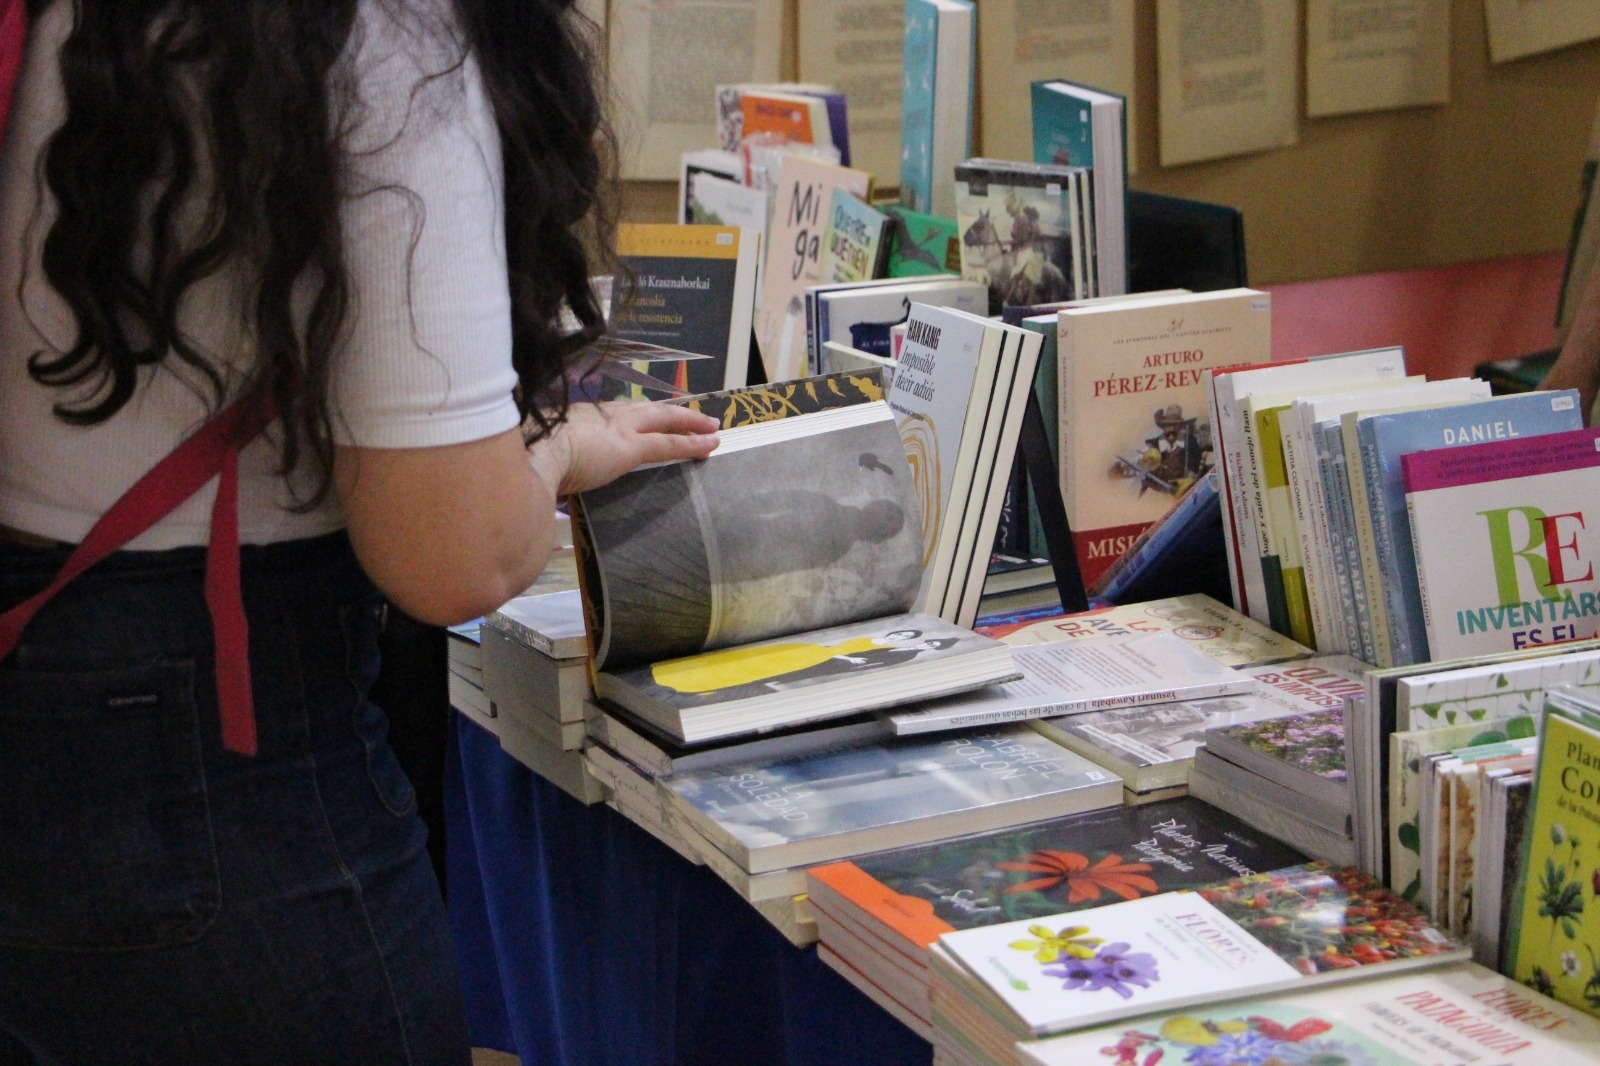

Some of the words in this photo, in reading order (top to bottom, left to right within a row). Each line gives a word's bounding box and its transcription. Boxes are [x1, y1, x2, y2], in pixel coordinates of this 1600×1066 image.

[788, 180, 822, 227] Mi
[792, 229, 819, 281] ga
[648, 275, 710, 290] Krasznahorkai
[640, 312, 683, 324] resistencia
[907, 318, 924, 343] HAN
[920, 323, 941, 350] KANG
[900, 345, 936, 375] Imposible
[1143, 349, 1204, 369] ARTURO
[894, 370, 915, 393] decir
[913, 379, 935, 402] adiós
[1093, 362, 1252, 397] PÉREZ-REV
[1240, 409, 1251, 433] Bam
[1443, 420, 1519, 445] DANIEL
[1244, 436, 1257, 470] conejo
[1367, 444, 1378, 478] DANIEL
[1233, 451, 1246, 486] Richard
[1250, 472, 1259, 488] del
[1284, 434, 1296, 469] LAETITIA
[1290, 470, 1304, 520] COLOMBANI
[1239, 490, 1251, 519] Adams
[1253, 491, 1264, 518] caída
[1087, 528, 1146, 559] MISI
[1301, 534, 1307, 543] EL
[1303, 543, 1312, 572] VUELO
[1331, 532, 1351, 607] CRIANZA
[1475, 506, 1593, 610] RE
[1307, 572, 1314, 584] DE
[1345, 537, 1366, 612] CRIANZA
[1310, 586, 1316, 596] LA
[1419, 586, 1431, 626] CAMINO
[1311, 596, 1323, 634] COMETA
[1456, 590, 1600, 635] INVENTAR
[1253, 672, 1290, 684] ES
[1028, 707, 1040, 716] las
[1042, 705, 1053, 715] de
[1055, 703, 1073, 711] casa
[1076, 701, 1087, 711] La
[1091, 695, 1135, 709] Kawabata
[1137, 690, 1176, 703] Yasunari
[980, 735, 1065, 780] ABRIEL
[730, 773, 809, 822] SOLEDAD
[1151, 818, 1202, 848] Plantas
[1395, 989, 1533, 1056] PATAGONIA
[1472, 988, 1577, 1031] FLORES
